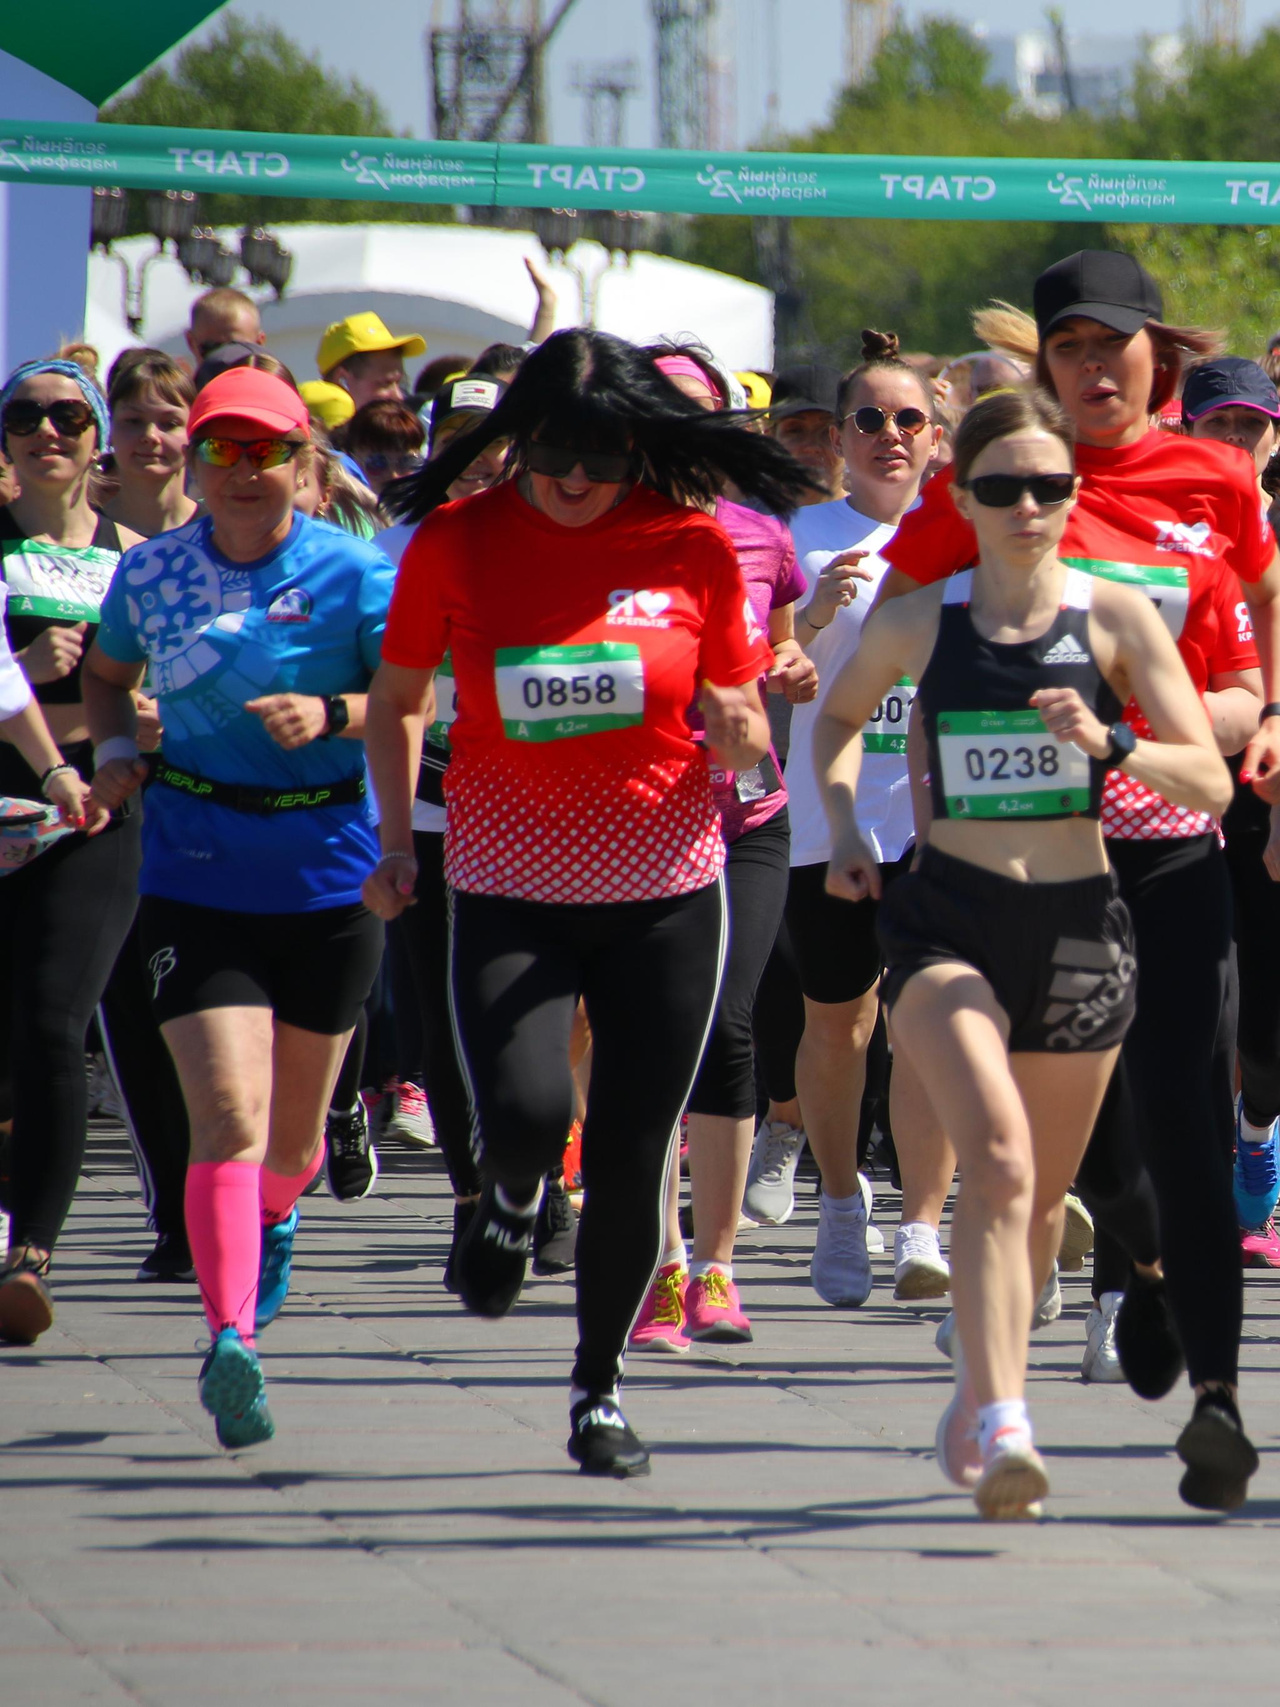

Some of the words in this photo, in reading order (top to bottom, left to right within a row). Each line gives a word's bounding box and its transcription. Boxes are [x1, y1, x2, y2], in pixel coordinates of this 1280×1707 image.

[607, 589, 635, 616] Я
[1043, 653, 1090, 664] adidas
[522, 673, 616, 709] 0858
[965, 744, 1060, 781] 0238
[484, 1219, 529, 1251] FILA
[578, 1407, 625, 1434] FILA
